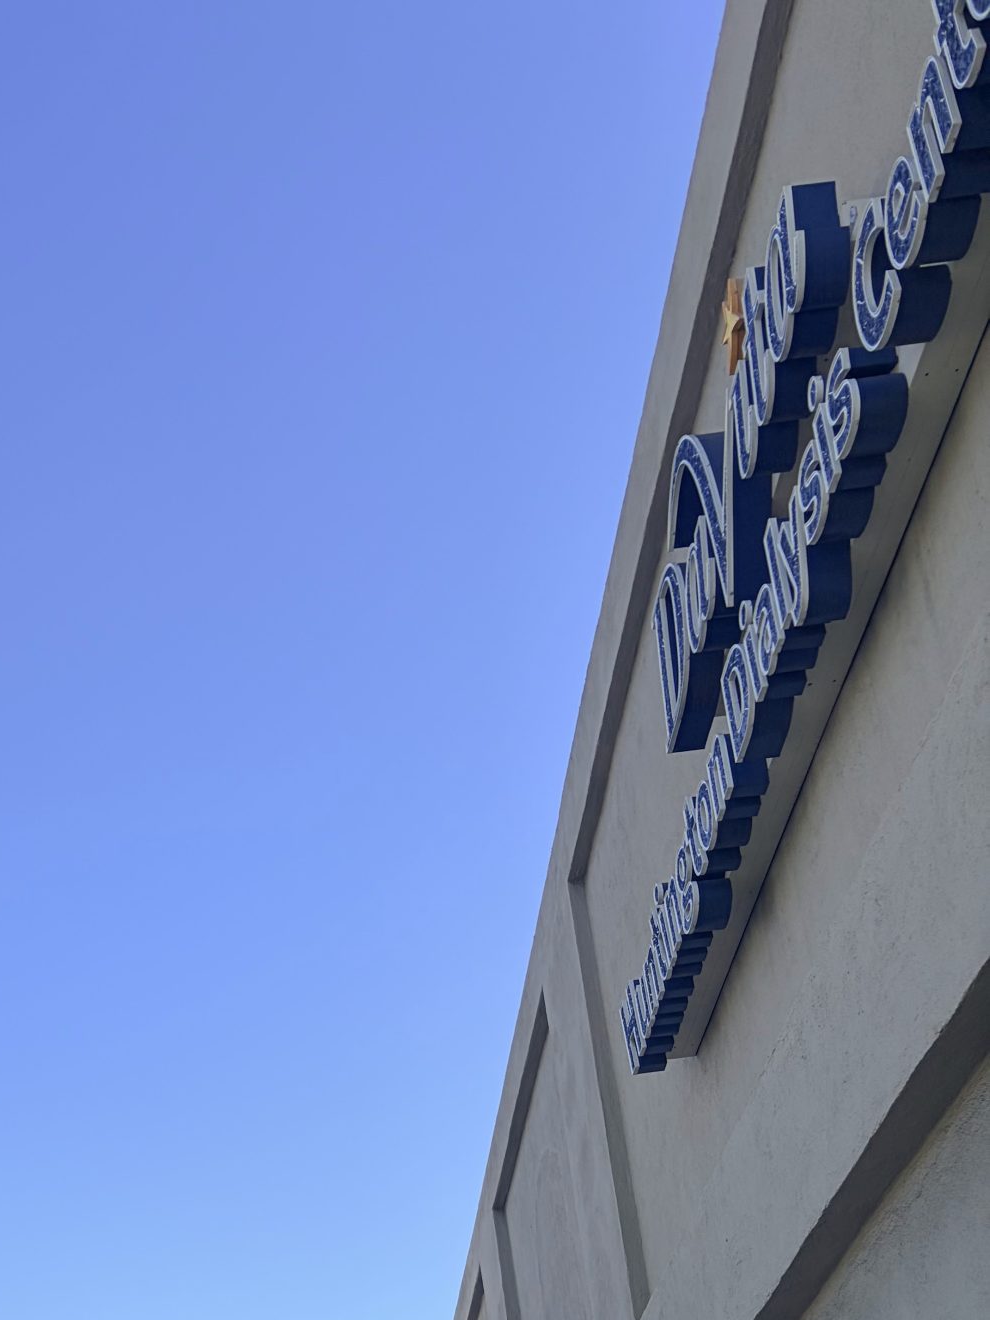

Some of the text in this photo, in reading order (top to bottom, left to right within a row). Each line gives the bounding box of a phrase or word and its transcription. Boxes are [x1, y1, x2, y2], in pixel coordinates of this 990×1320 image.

[619, 0, 990, 1075] Huntington Dialysis Cent
[652, 184, 808, 754] DaVita
